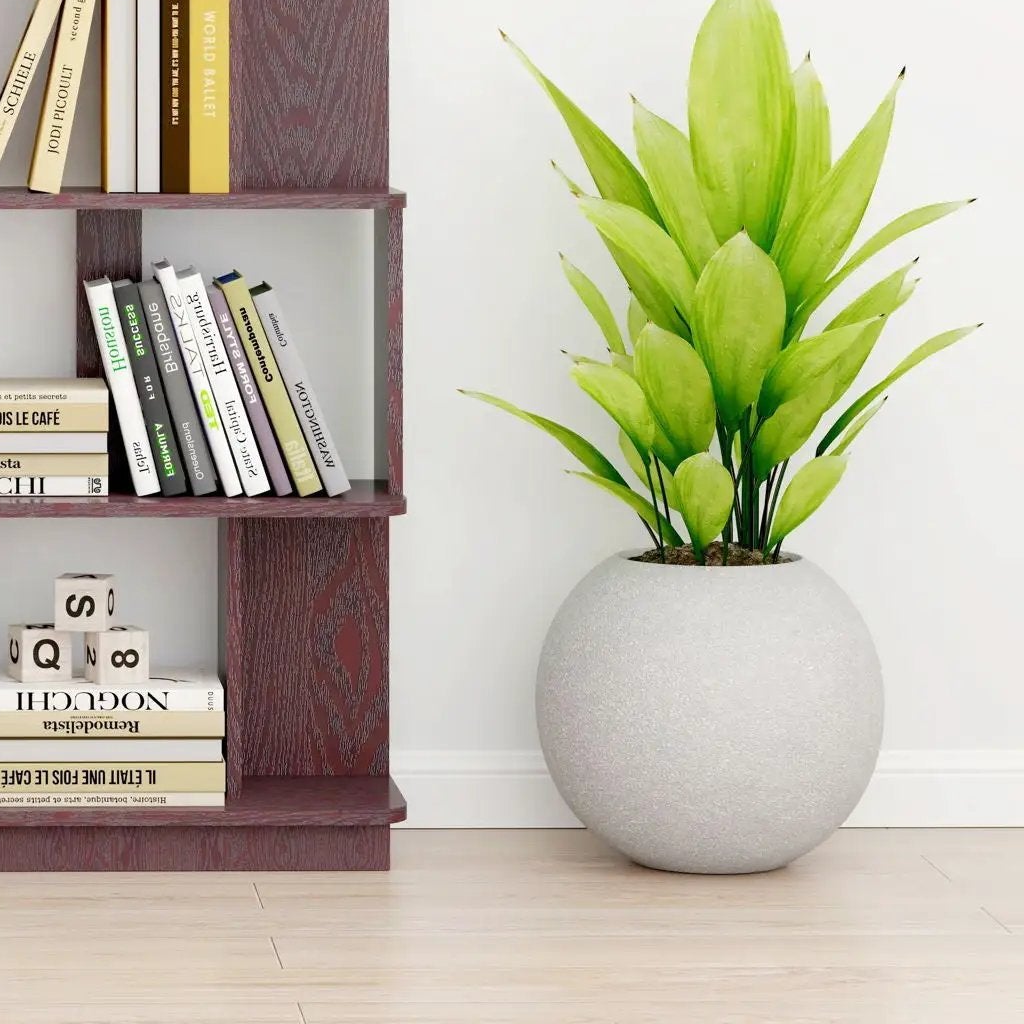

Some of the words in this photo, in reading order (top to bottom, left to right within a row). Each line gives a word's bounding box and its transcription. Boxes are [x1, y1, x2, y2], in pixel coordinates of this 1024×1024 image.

[70, 7, 82, 42] second
[202, 11, 217, 63] WORLD
[3, 51, 37, 116] SCHIELE
[53, 64, 73, 121] PICOULT
[202, 69, 217, 118] BALLET
[47, 122, 63, 154] JODI
[14, 393, 37, 402] petits
[16, 411, 29, 426] LE
[31, 408, 61, 426] CAFÉ
[32, 638, 61, 671] Q
[16, 691, 169, 711] NOGUCHI
[42, 720, 140, 734] Remodelista
[0, 769, 32, 788] CAFÉ
[34, 769, 49, 785] LE
[52, 769, 79, 785] FOIS
[82, 769, 105, 785] UNE
[108, 769, 143, 788] ÉTAIT
[145, 769, 157, 785] IL
[85, 795, 128, 804] botanique,
[130, 795, 167, 804] Histoire,
